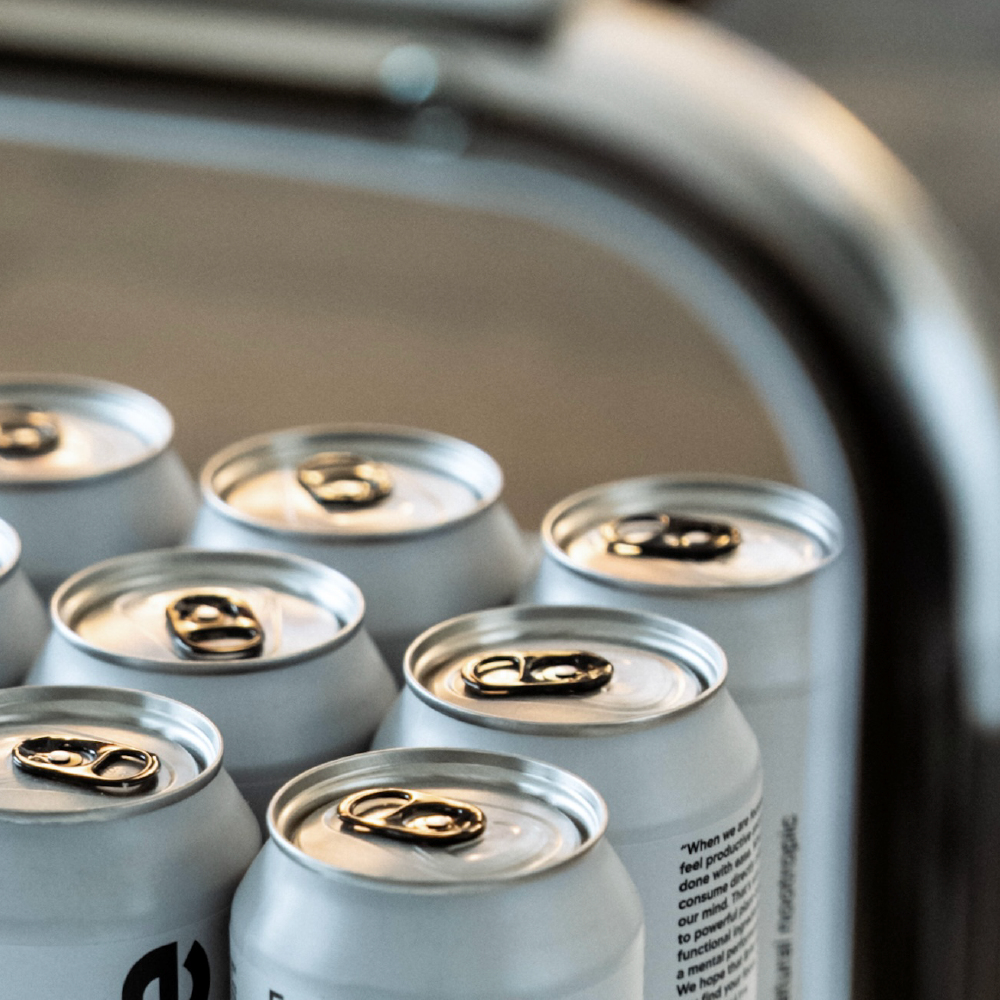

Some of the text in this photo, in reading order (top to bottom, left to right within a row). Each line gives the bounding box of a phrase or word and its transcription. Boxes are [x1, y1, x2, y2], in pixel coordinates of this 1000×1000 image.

[722, 827, 736, 842] we
[678, 874, 710, 893] done
[712, 861, 733, 880] with
[680, 856, 703, 875] feel
[678, 883, 728, 910] consume
[677, 913, 699, 927] our
[678, 933, 691, 945] to
[694, 908, 738, 943] powerful
[677, 928, 731, 962] functional
[676, 969, 685, 980] a
[688, 950, 725, 977] mental
[676, 981, 697, 997] We
[699, 969, 726, 991] hope
